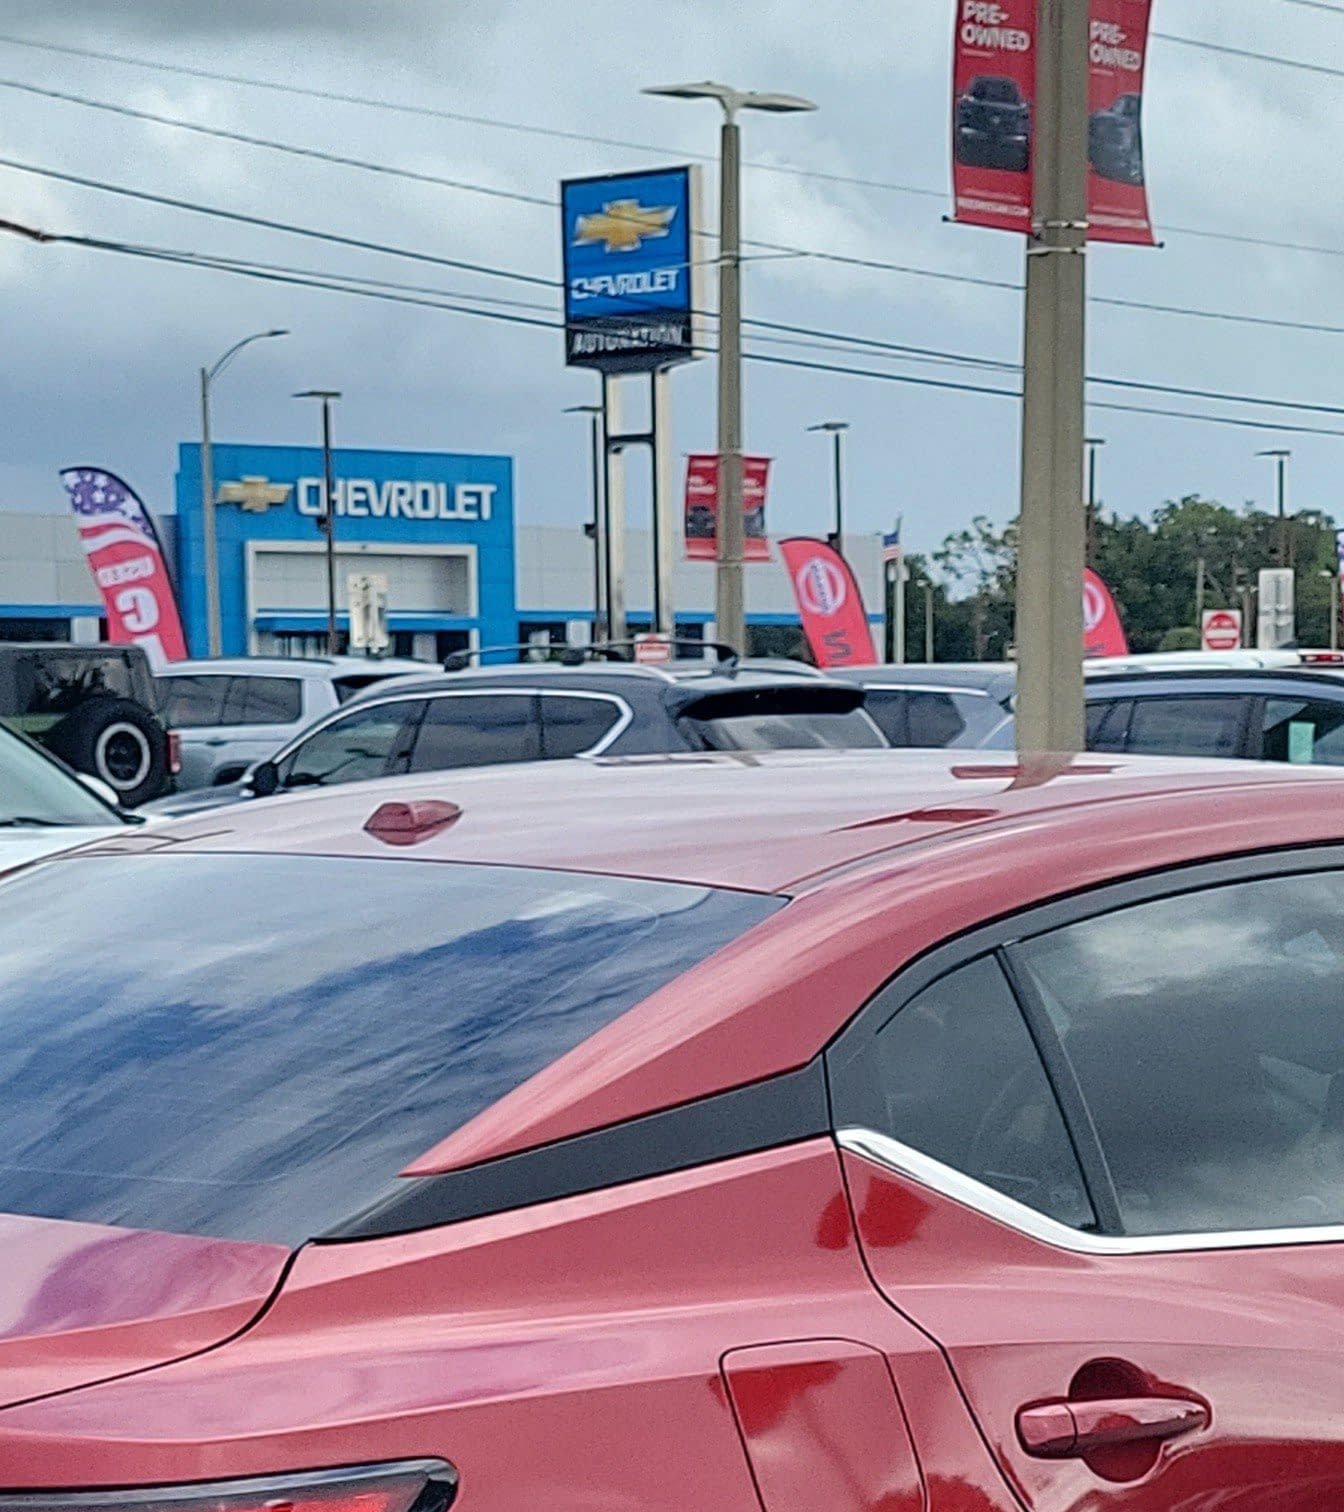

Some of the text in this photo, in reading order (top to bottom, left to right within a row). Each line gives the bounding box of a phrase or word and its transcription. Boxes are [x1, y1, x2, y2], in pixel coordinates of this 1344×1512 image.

[962, 1, 1009, 24] PRE-
[961, 23, 1031, 52] OWNED
[571, 269, 679, 299] CHEVROLET
[296, 476, 498, 521] CHEVROLET
